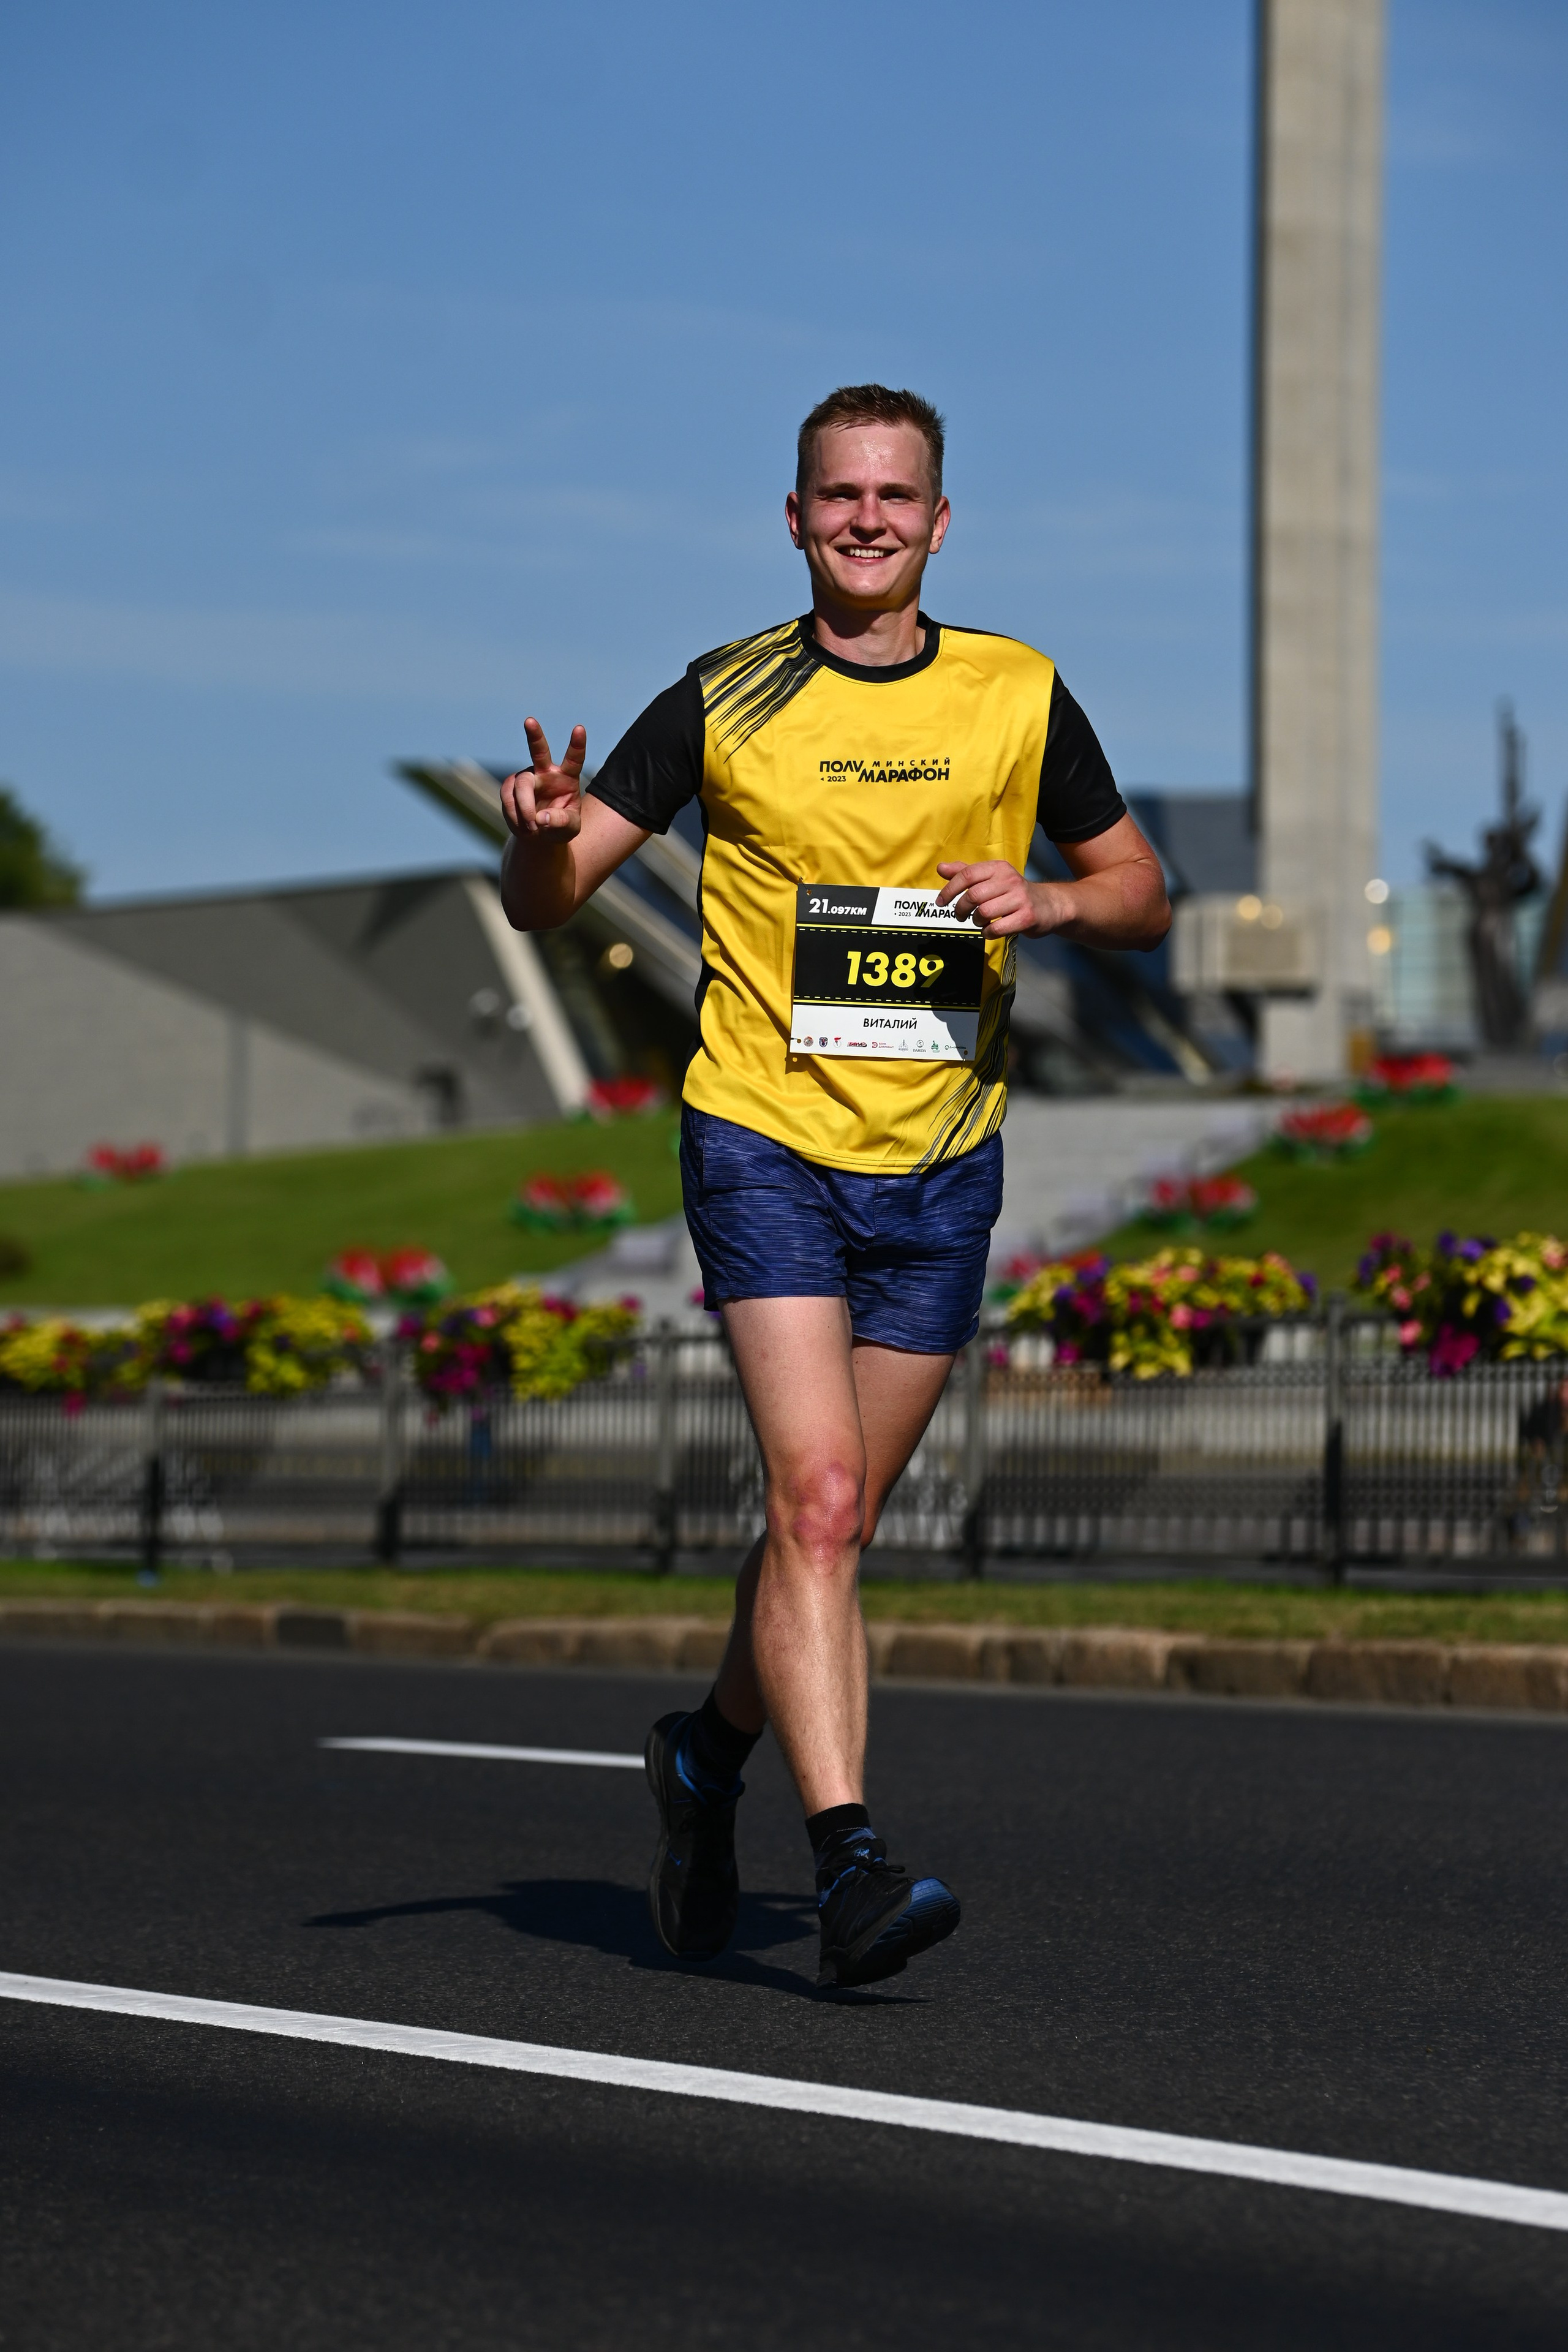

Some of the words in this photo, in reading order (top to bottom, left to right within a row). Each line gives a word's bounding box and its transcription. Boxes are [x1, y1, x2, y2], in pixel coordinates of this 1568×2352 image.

[872, 757, 950, 767] МИНСКИЙ
[858, 767, 950, 783] МАРАФОН
[916, 907, 973, 920] МАРАФ
[847, 951, 944, 988] 1389
[863, 1017, 918, 1030] ВИТАЛИЙ
